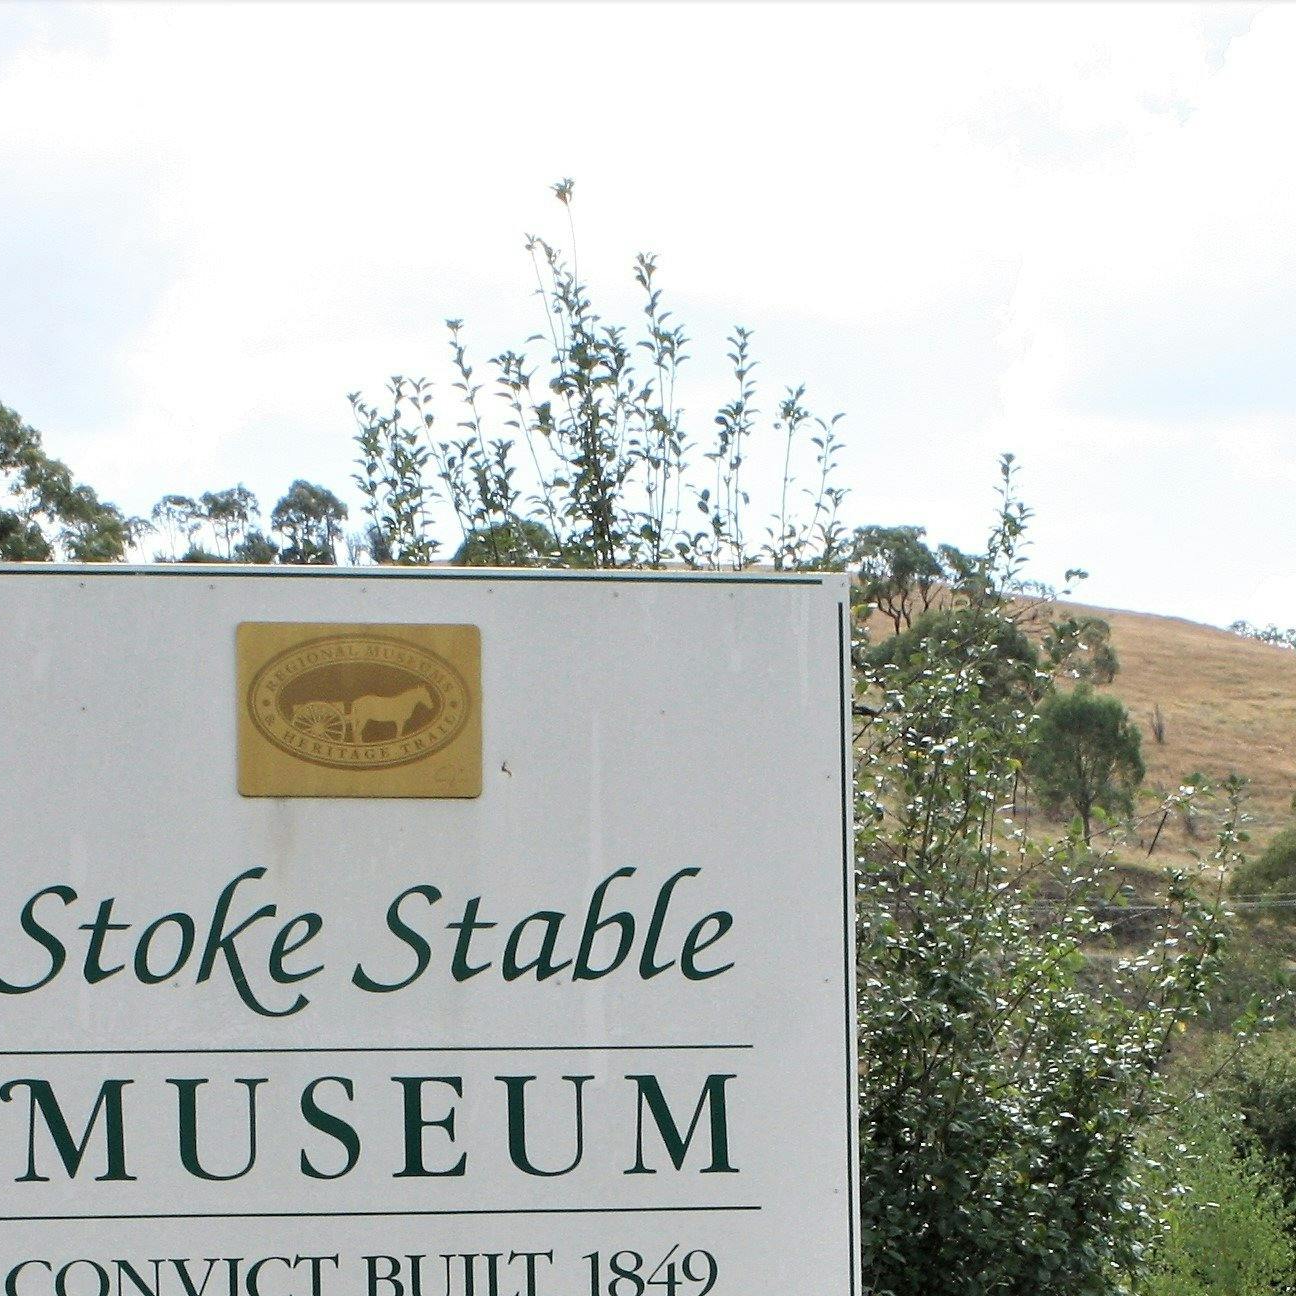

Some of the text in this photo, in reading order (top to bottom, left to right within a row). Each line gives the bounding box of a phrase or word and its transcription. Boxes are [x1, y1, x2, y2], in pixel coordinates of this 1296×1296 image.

[266, 645, 454, 693] REGIONAL MUSEUMS
[282, 731, 391, 760] HERITAGE
[401, 714, 456, 755] TRAIL
[352, 866, 735, 994] Stable
